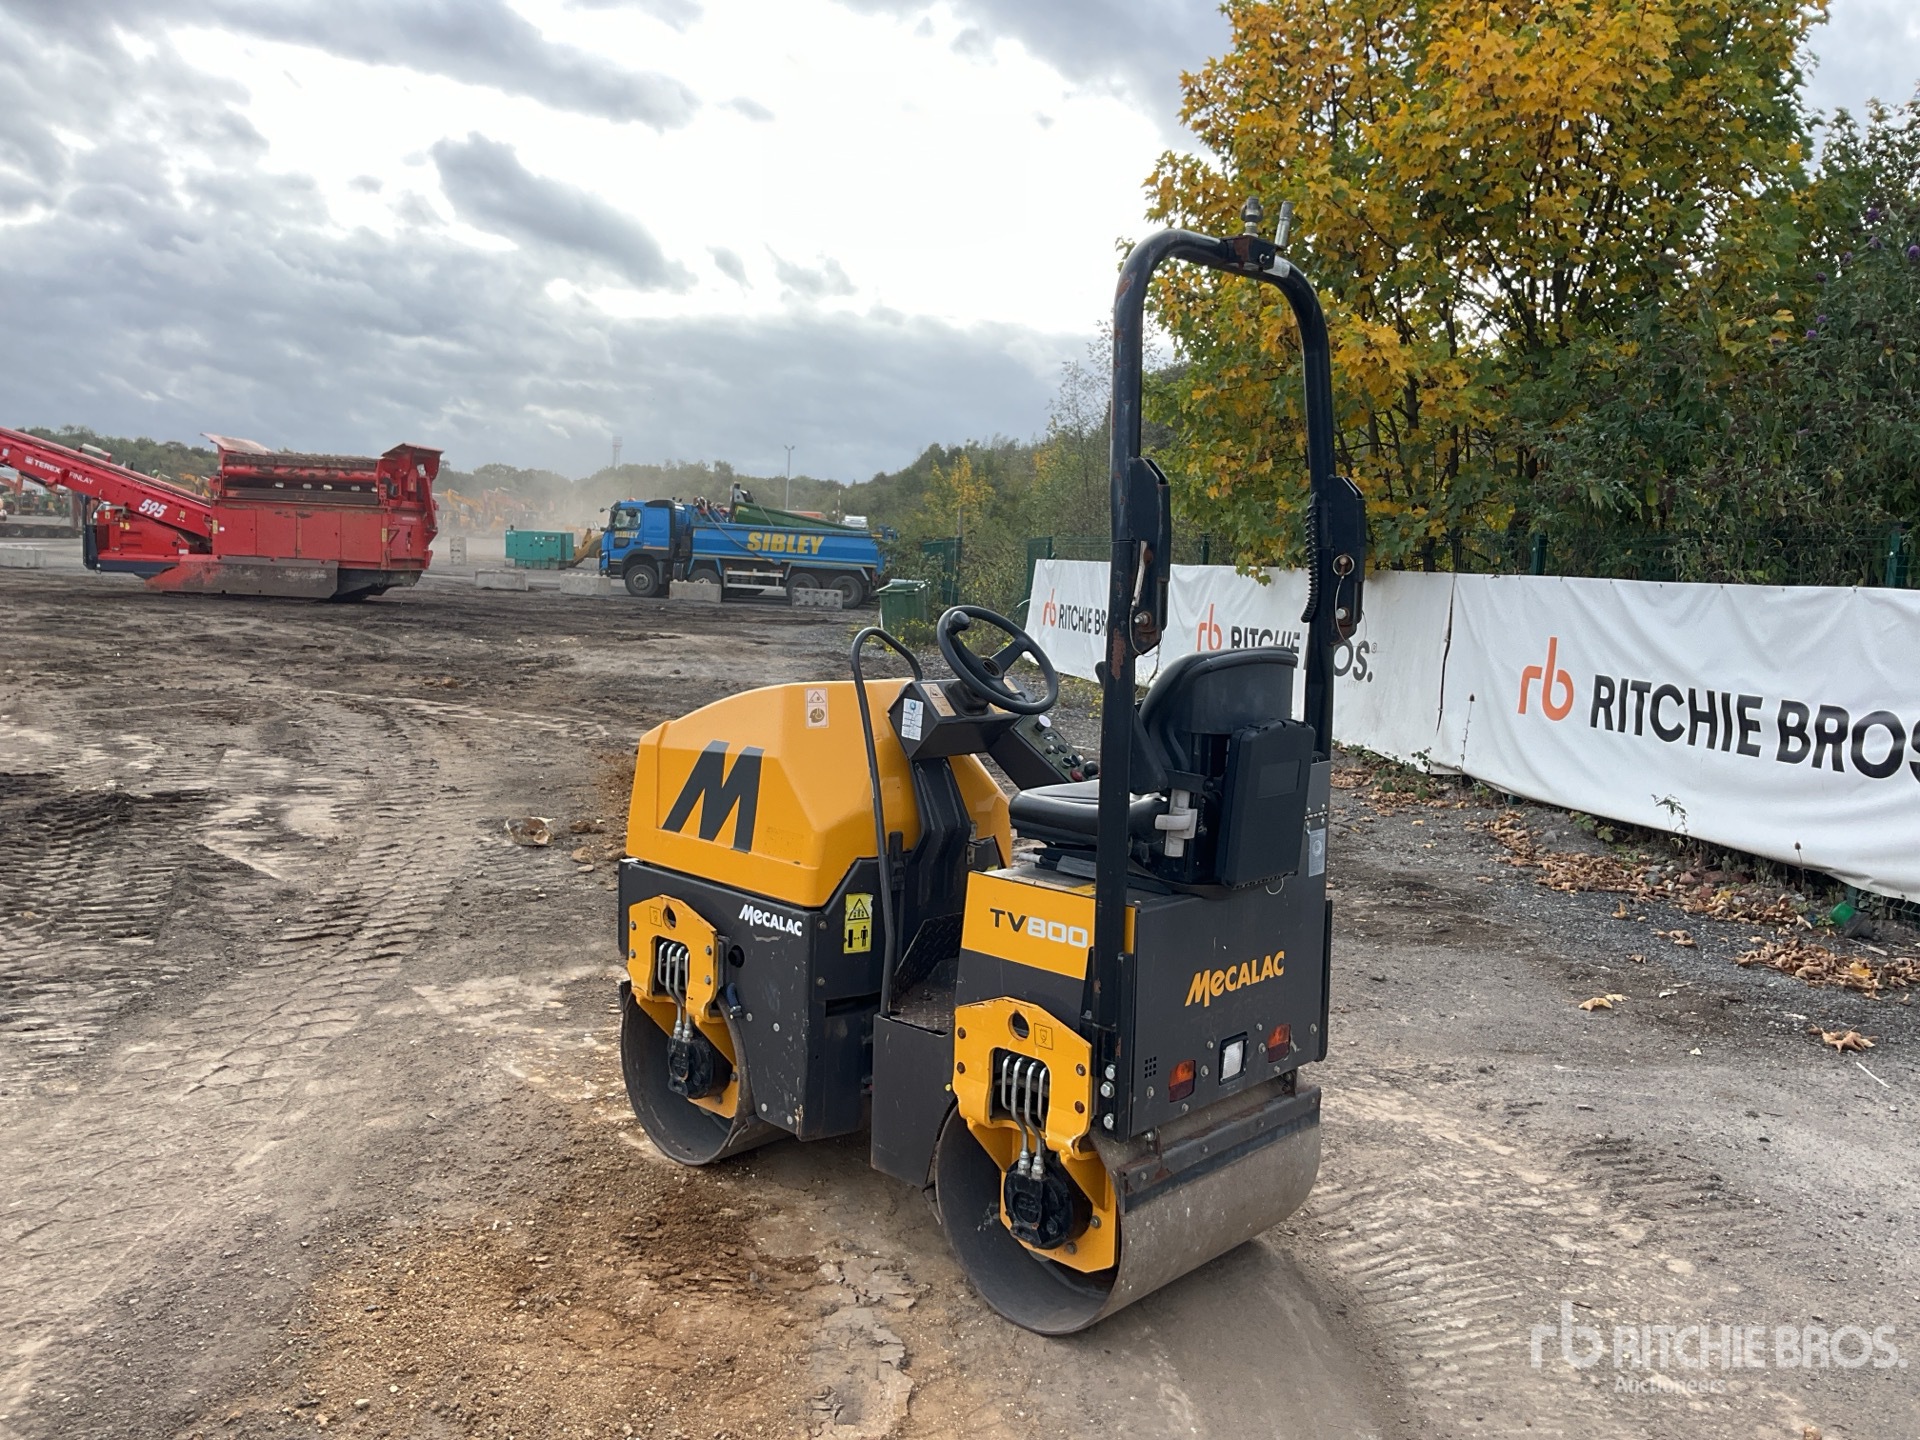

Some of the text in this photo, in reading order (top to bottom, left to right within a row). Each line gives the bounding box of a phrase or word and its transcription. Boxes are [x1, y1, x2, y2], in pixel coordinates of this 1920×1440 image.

[33, 459, 95, 486] TEREX FINLAY
[138, 499, 168, 518] 595
[747, 531, 825, 555] SIBLEY
[1059, 604, 1093, 634] RITCHIE
[1590, 674, 1764, 758] RITCHIE
[989, 907, 1089, 949] TV800
